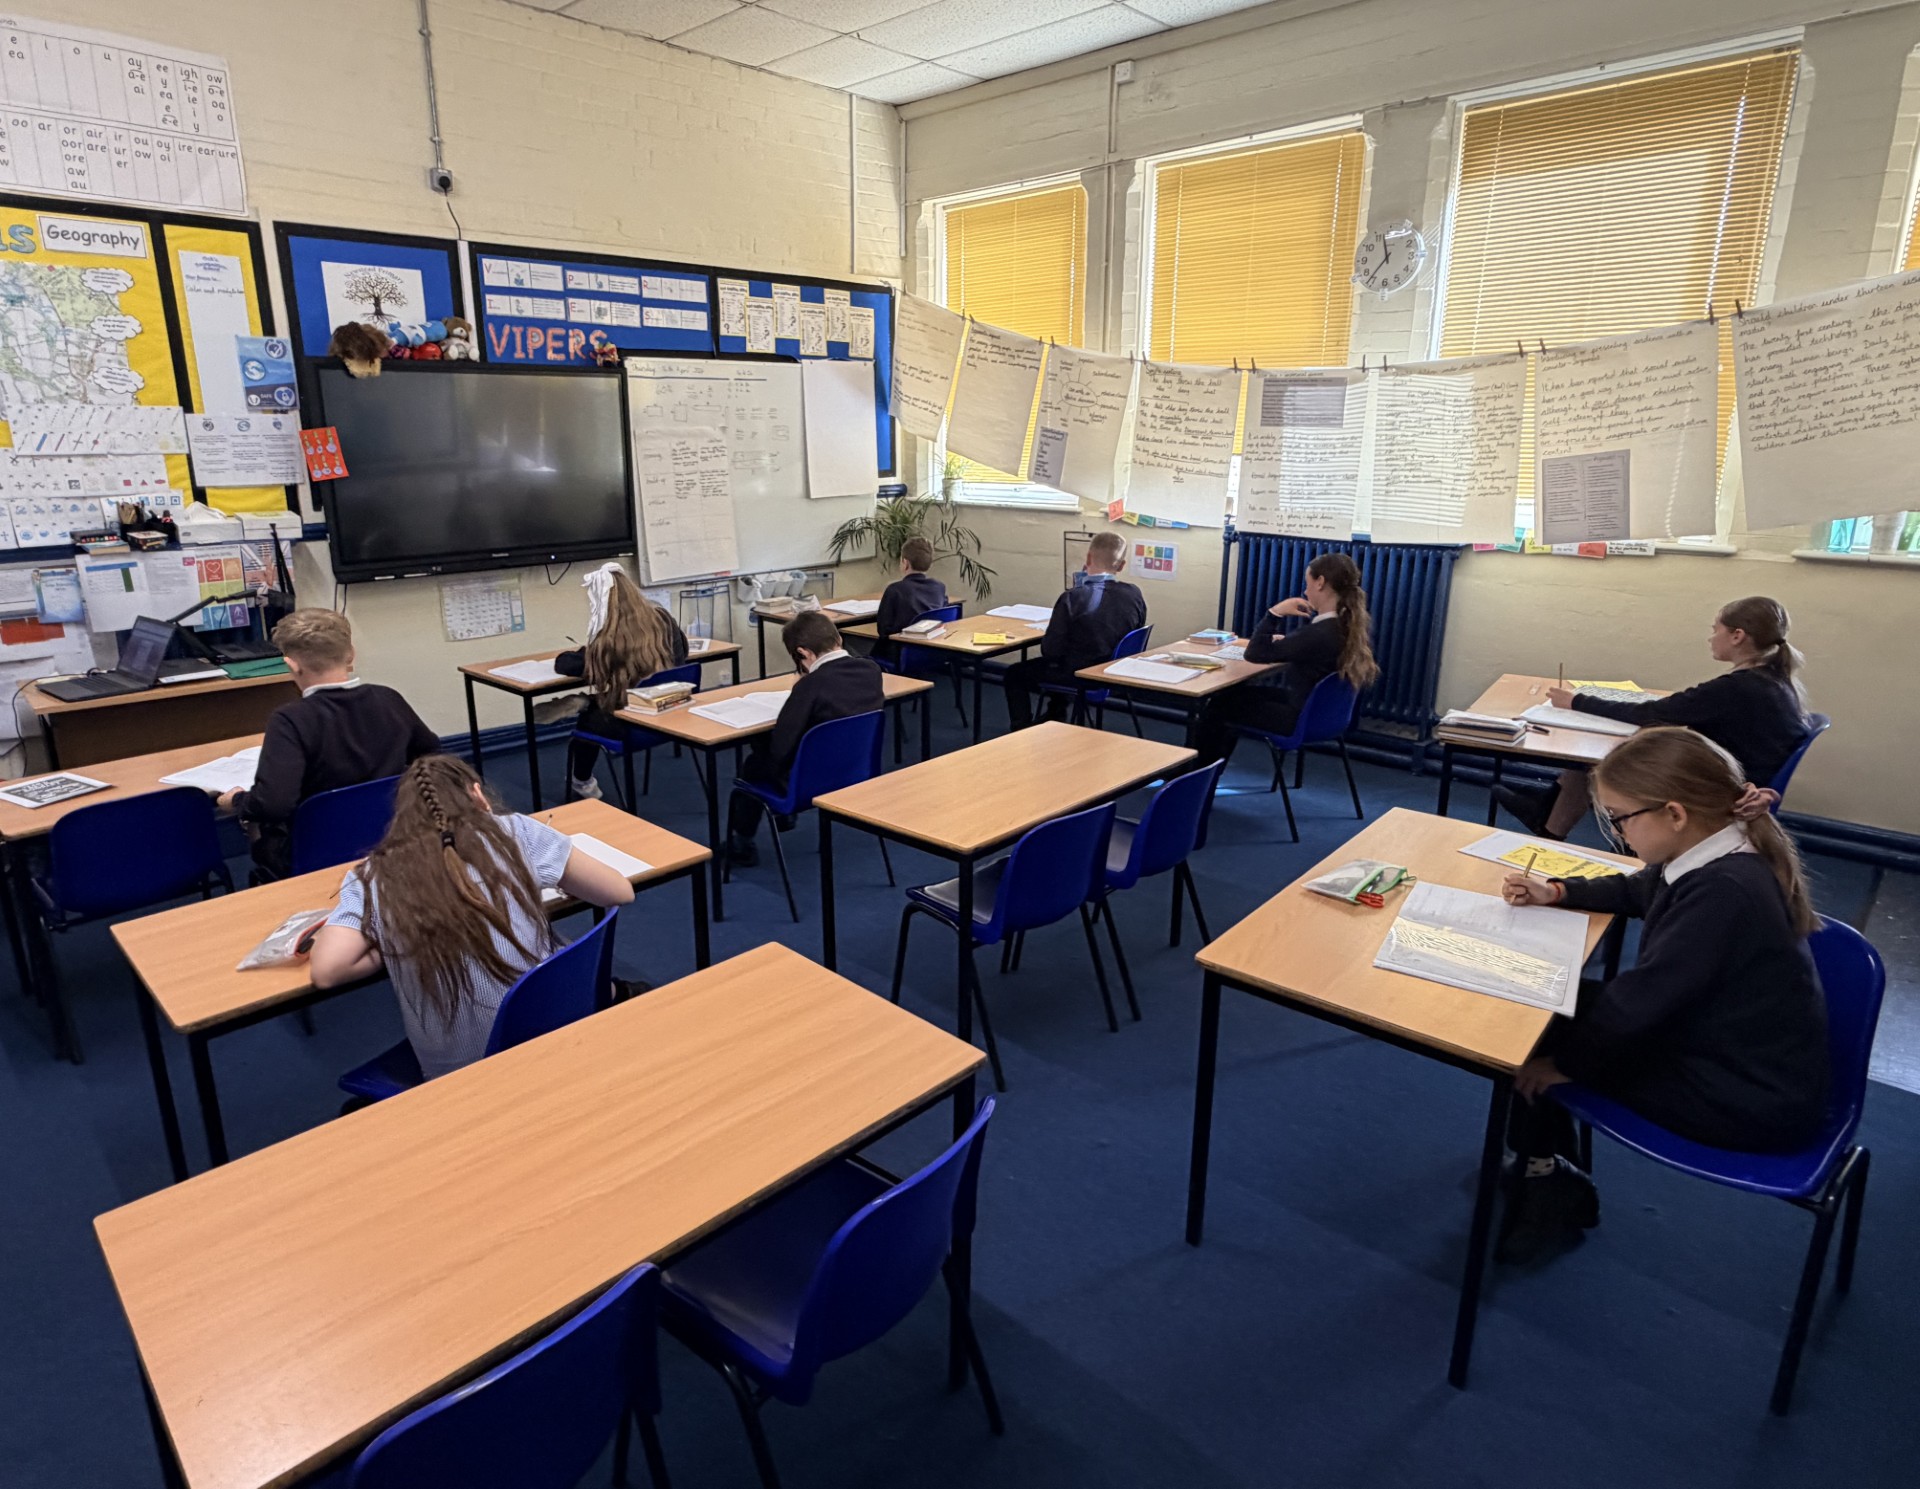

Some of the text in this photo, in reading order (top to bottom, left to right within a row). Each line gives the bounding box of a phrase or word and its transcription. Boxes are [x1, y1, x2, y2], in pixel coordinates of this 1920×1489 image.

[10, 36, 18, 45] e
[8, 50, 25, 60] ea
[73, 46, 81, 55] o
[103, 52, 112, 61] u
[127, 57, 143, 70] ay
[156, 63, 169, 73] ee
[180, 67, 199, 80] igh
[161, 77, 168, 89] y
[206, 74, 223, 84] ow
[133, 84, 145, 95] ai
[159, 90, 173, 100] ea
[187, 93, 198, 104] ie
[164, 104, 171, 113] e
[211, 99, 226, 110] oa
[216, 113, 224, 122] o
[11, 118, 29, 128] oo
[38, 121, 52, 132] ar
[193, 122, 200, 133] y
[63, 126, 76, 136] or
[86, 129, 103, 140] air
[114, 132, 123, 142] ir
[133, 136, 149, 146] ou
[61, 139, 83, 150] oor
[86, 143, 108, 154] are
[156, 140, 171, 153] oy
[178, 142, 193, 153] ire
[114, 146, 127, 156] ur
[134, 150, 152, 160] ow
[197, 146, 215, 156] ear
[218, 149, 237, 160] ure
[64, 153, 85, 163] ore
[160, 153, 171, 163] oi
[116, 160, 129, 169] er
[67, 167, 86, 177] aw
[71, 181, 88, 191] au
[46, 224, 141, 251] Geography
[1375, 234, 1382, 242] 11
[1406, 239, 1413, 248] 2
[1361, 256, 1368, 265] 9
[1408, 251, 1415, 260] 3
[1363, 268, 1370, 277] 8
[1403, 264, 1409, 273] 4
[1371, 276, 1377, 284] 7
[1382, 279, 1389, 287] 6
[1393, 274, 1400, 283] 5
[1777, 303, 1818, 318] children
[1821, 293, 1848, 307] under
[1856, 283, 1894, 298] thirteen
[1740, 342, 1756, 351] The
[1761, 333, 1790, 347] twenty
[1817, 320, 1853, 334] century
[1869, 307, 1890, 319] the
[1864, 323, 1874, 331] to
[1879, 319, 1896, 328] the
[487, 322, 608, 361] VIPERS
[1758, 364, 1783, 374] many
[1863, 337, 1889, 349] Daily
[1642, 359, 1669, 373] social
[1803, 361, 1844, 378] engaging
[1748, 389, 1764, 401] and
[1839, 391, 1865, 403] used
[1748, 400, 1766, 410] that
[1790, 434, 1816, 445] under
[1819, 426, 1858, 439] thirteen
